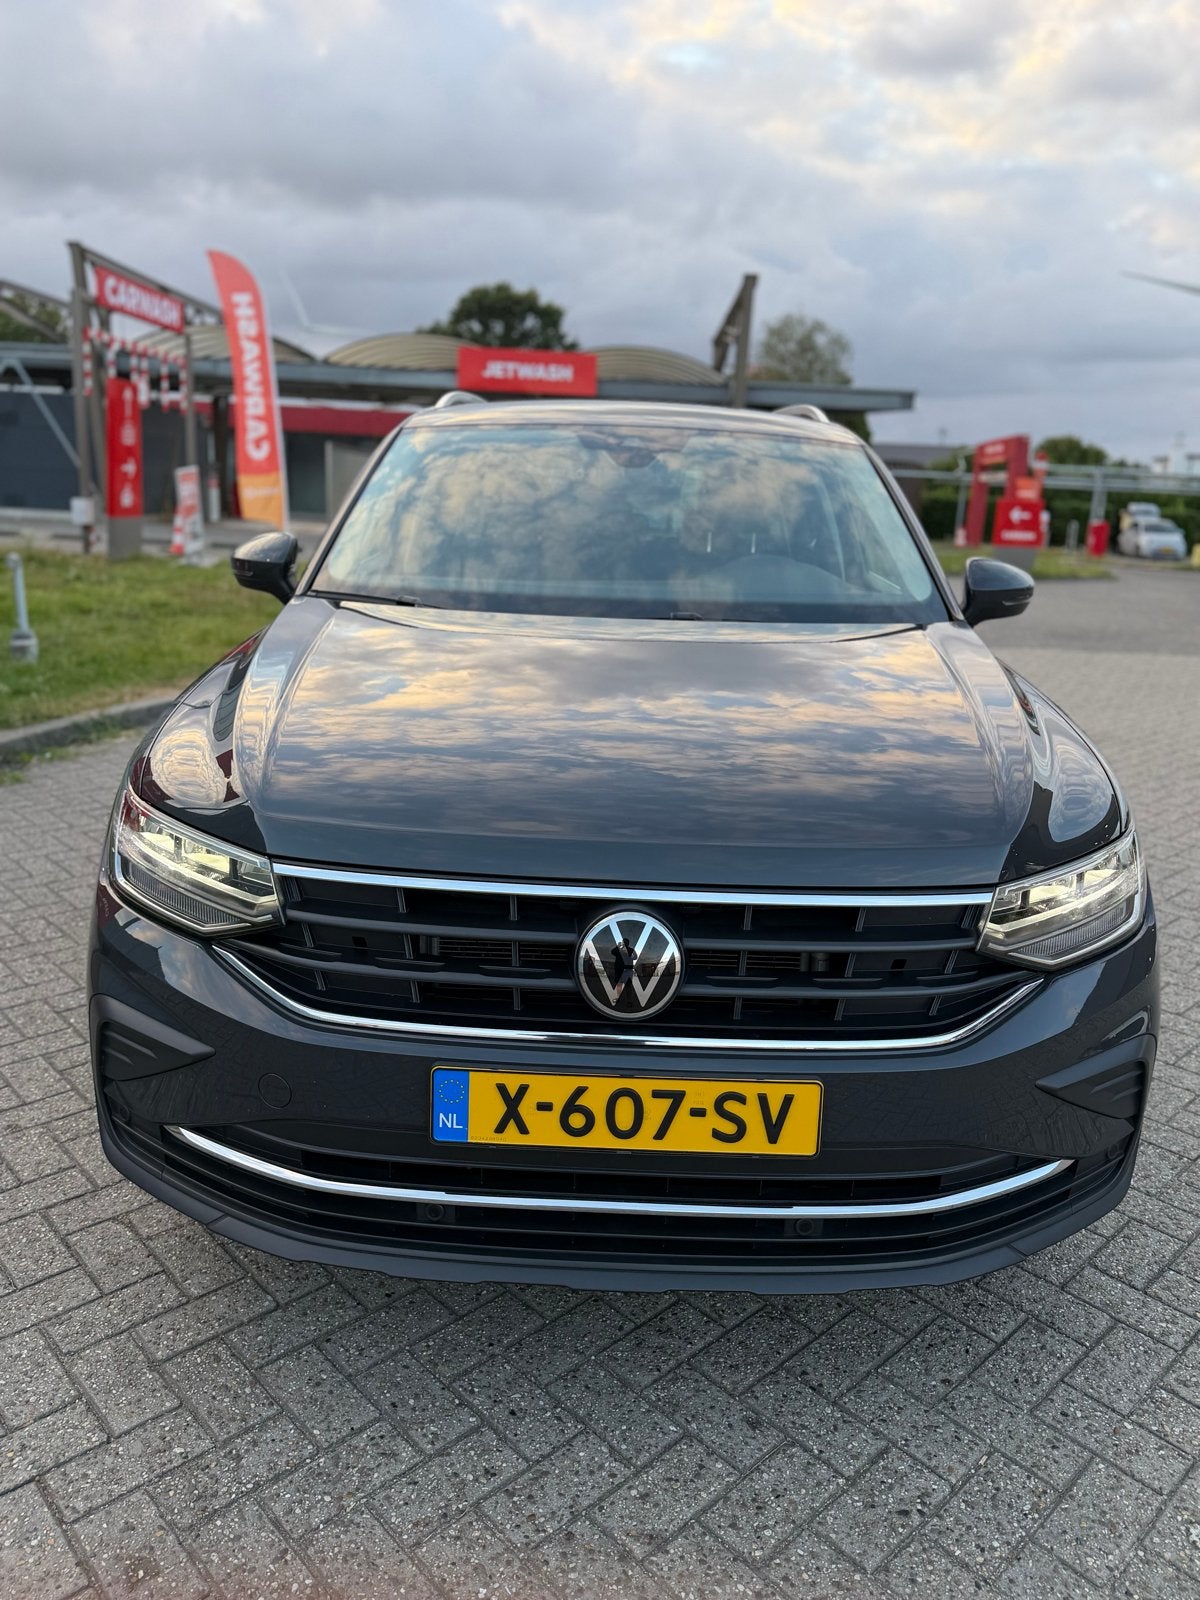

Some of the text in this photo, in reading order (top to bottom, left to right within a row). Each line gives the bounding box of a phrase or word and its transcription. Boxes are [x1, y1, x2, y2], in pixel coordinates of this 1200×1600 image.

[104, 275, 180, 326] CARWASH
[481, 360, 574, 382] JETWASH
[439, 1112, 463, 1129] NL
[493, 1082, 795, 1145] X-607-SV
